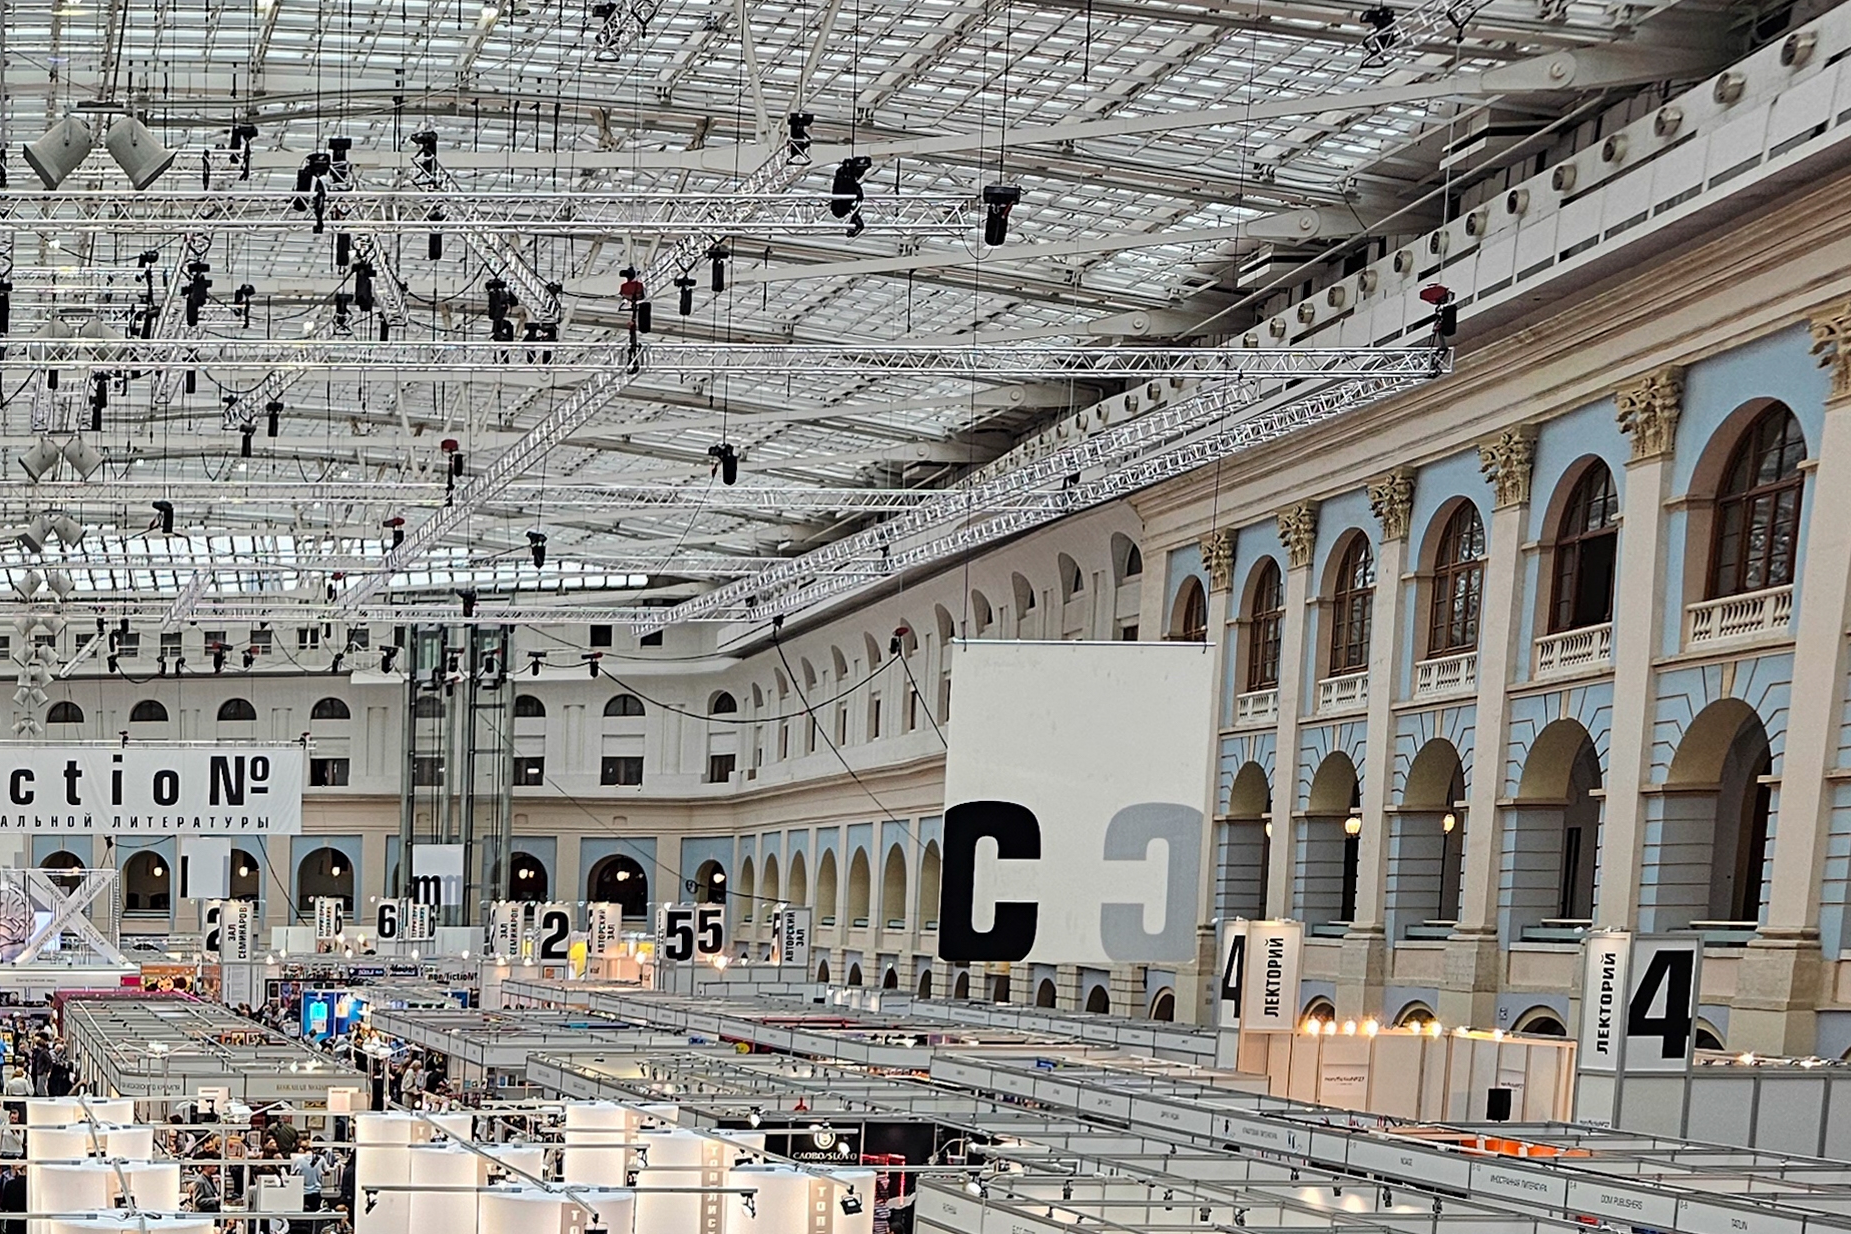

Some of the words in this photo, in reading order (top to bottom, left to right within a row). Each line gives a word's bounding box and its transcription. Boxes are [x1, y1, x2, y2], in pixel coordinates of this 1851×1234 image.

[112, 816, 269, 829] ЛИТЕРАТУРЫ
[227, 924, 237, 942] ЗАЛ
[238, 906, 248, 959] СЕМИНАРОВ
[334, 902, 343, 936] 6
[377, 904, 397, 939] 6
[500, 923, 509, 939] ЗАЛ
[510, 907, 519, 955] СЕМИНАРОВ
[540, 911, 569, 960] 2
[597, 909, 606, 954] АВТОРСКИЙ
[607, 924, 616, 940] ЗАЛ
[665, 911, 694, 961] 5
[697, 909, 723, 954] 5
[785, 911, 796, 962] АВТОРСКИЙ
[796, 928, 805, 947] ЗАЛ
[1222, 934, 1245, 1019] 4
[1263, 937, 1285, 1019] ЛЕКТОРИЙ
[1595, 952, 1617, 1056] ЛЕКТОРИЙ
[1627, 949, 1696, 1060] 4
[1600, 1194, 1617, 1207] DOM
[1618, 1196, 1644, 1210] PUBLISHERS
